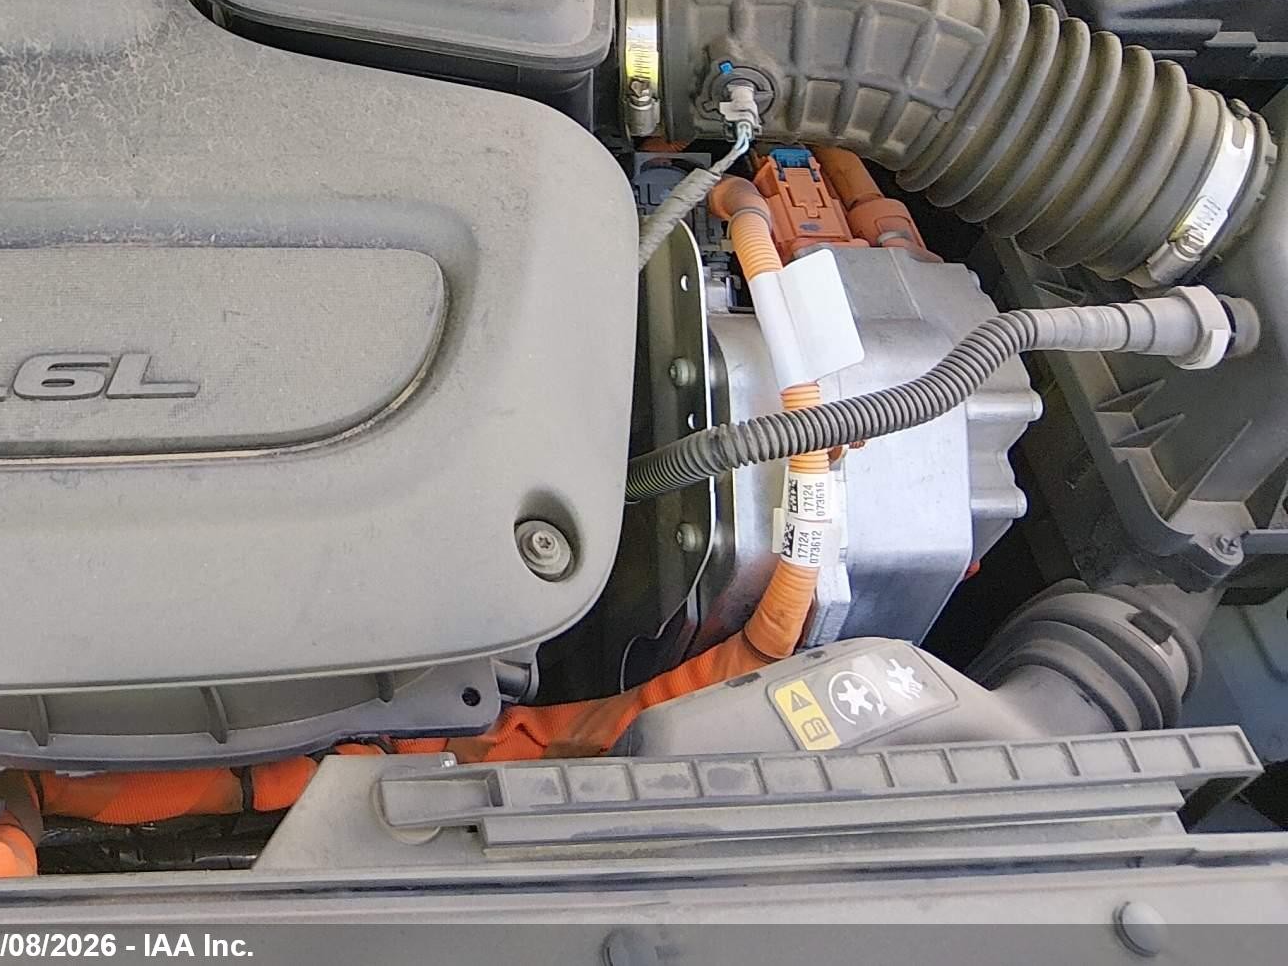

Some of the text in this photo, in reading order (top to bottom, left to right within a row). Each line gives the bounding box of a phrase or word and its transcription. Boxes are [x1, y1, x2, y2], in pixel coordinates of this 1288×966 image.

[803, 484, 814, 512] 17124
[797, 532, 809, 558] 17124
[810, 530, 822, 563] 073612
